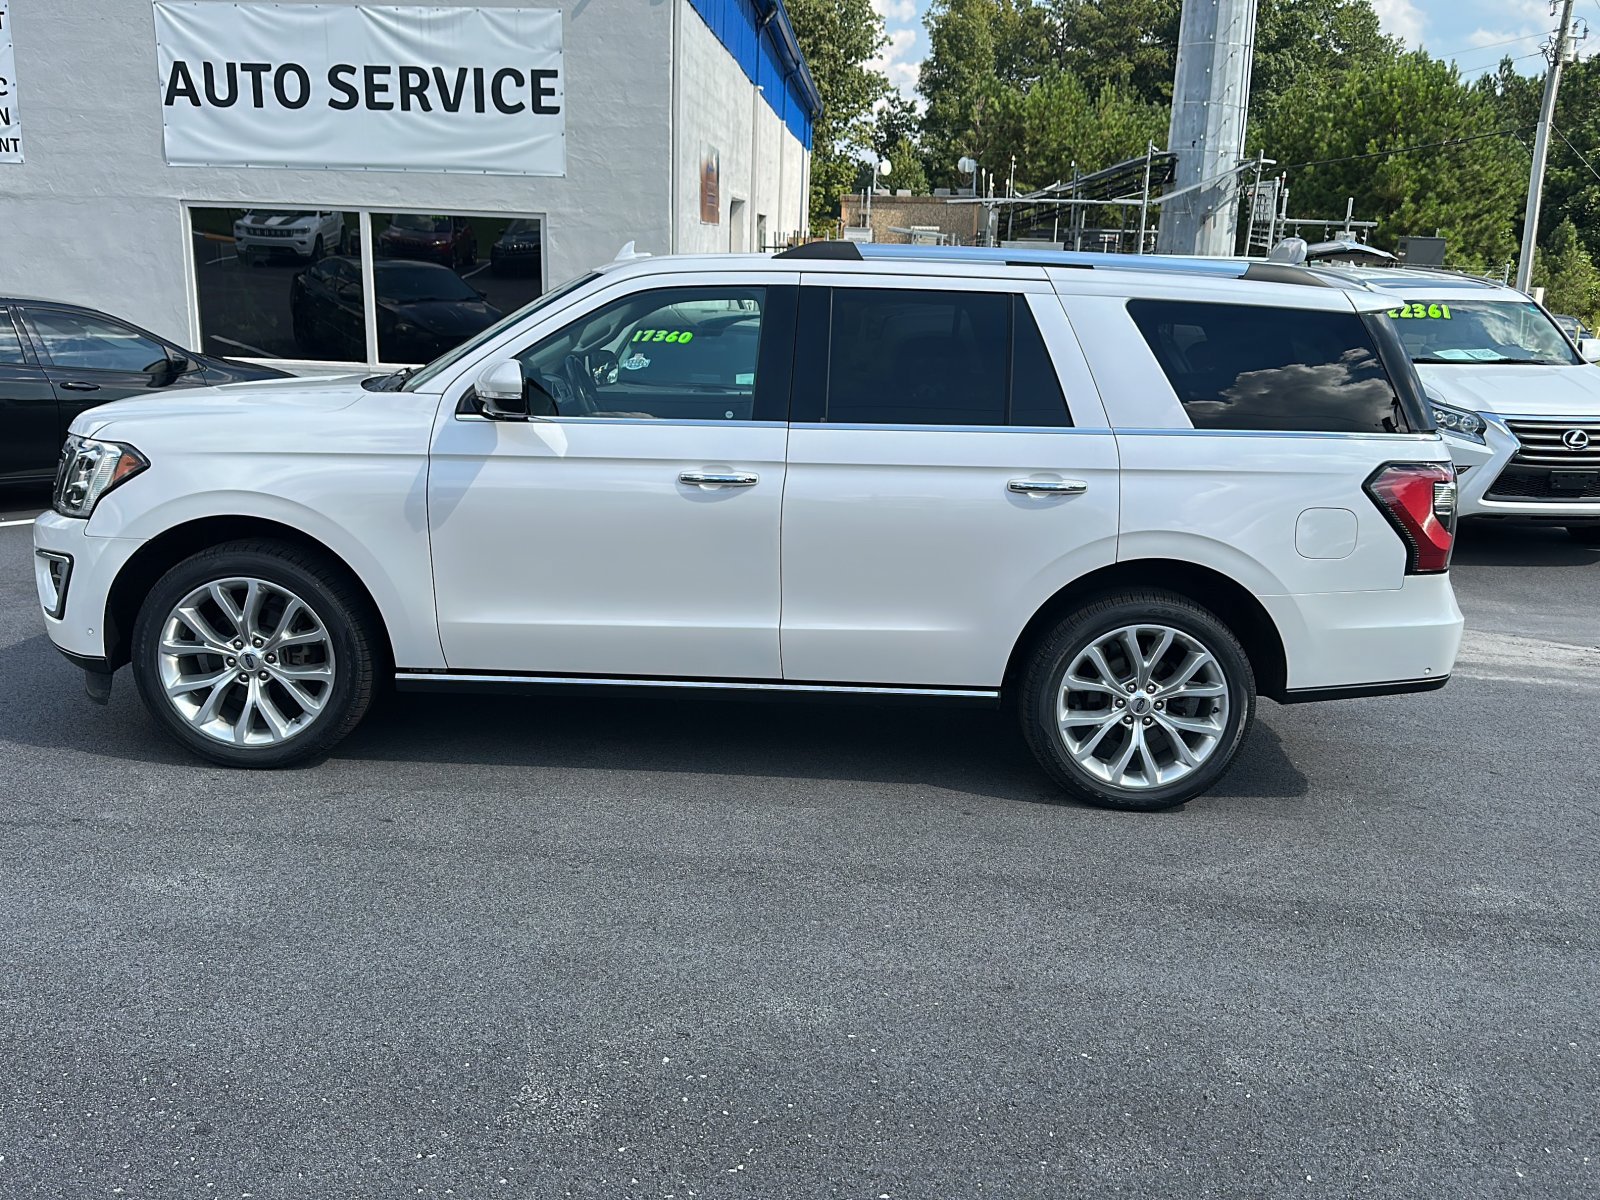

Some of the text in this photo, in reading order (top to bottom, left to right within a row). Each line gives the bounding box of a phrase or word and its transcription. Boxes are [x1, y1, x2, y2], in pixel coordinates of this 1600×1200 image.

[163, 60, 561, 115] AUTO SERVICE
[632, 329, 693, 344] 17360
